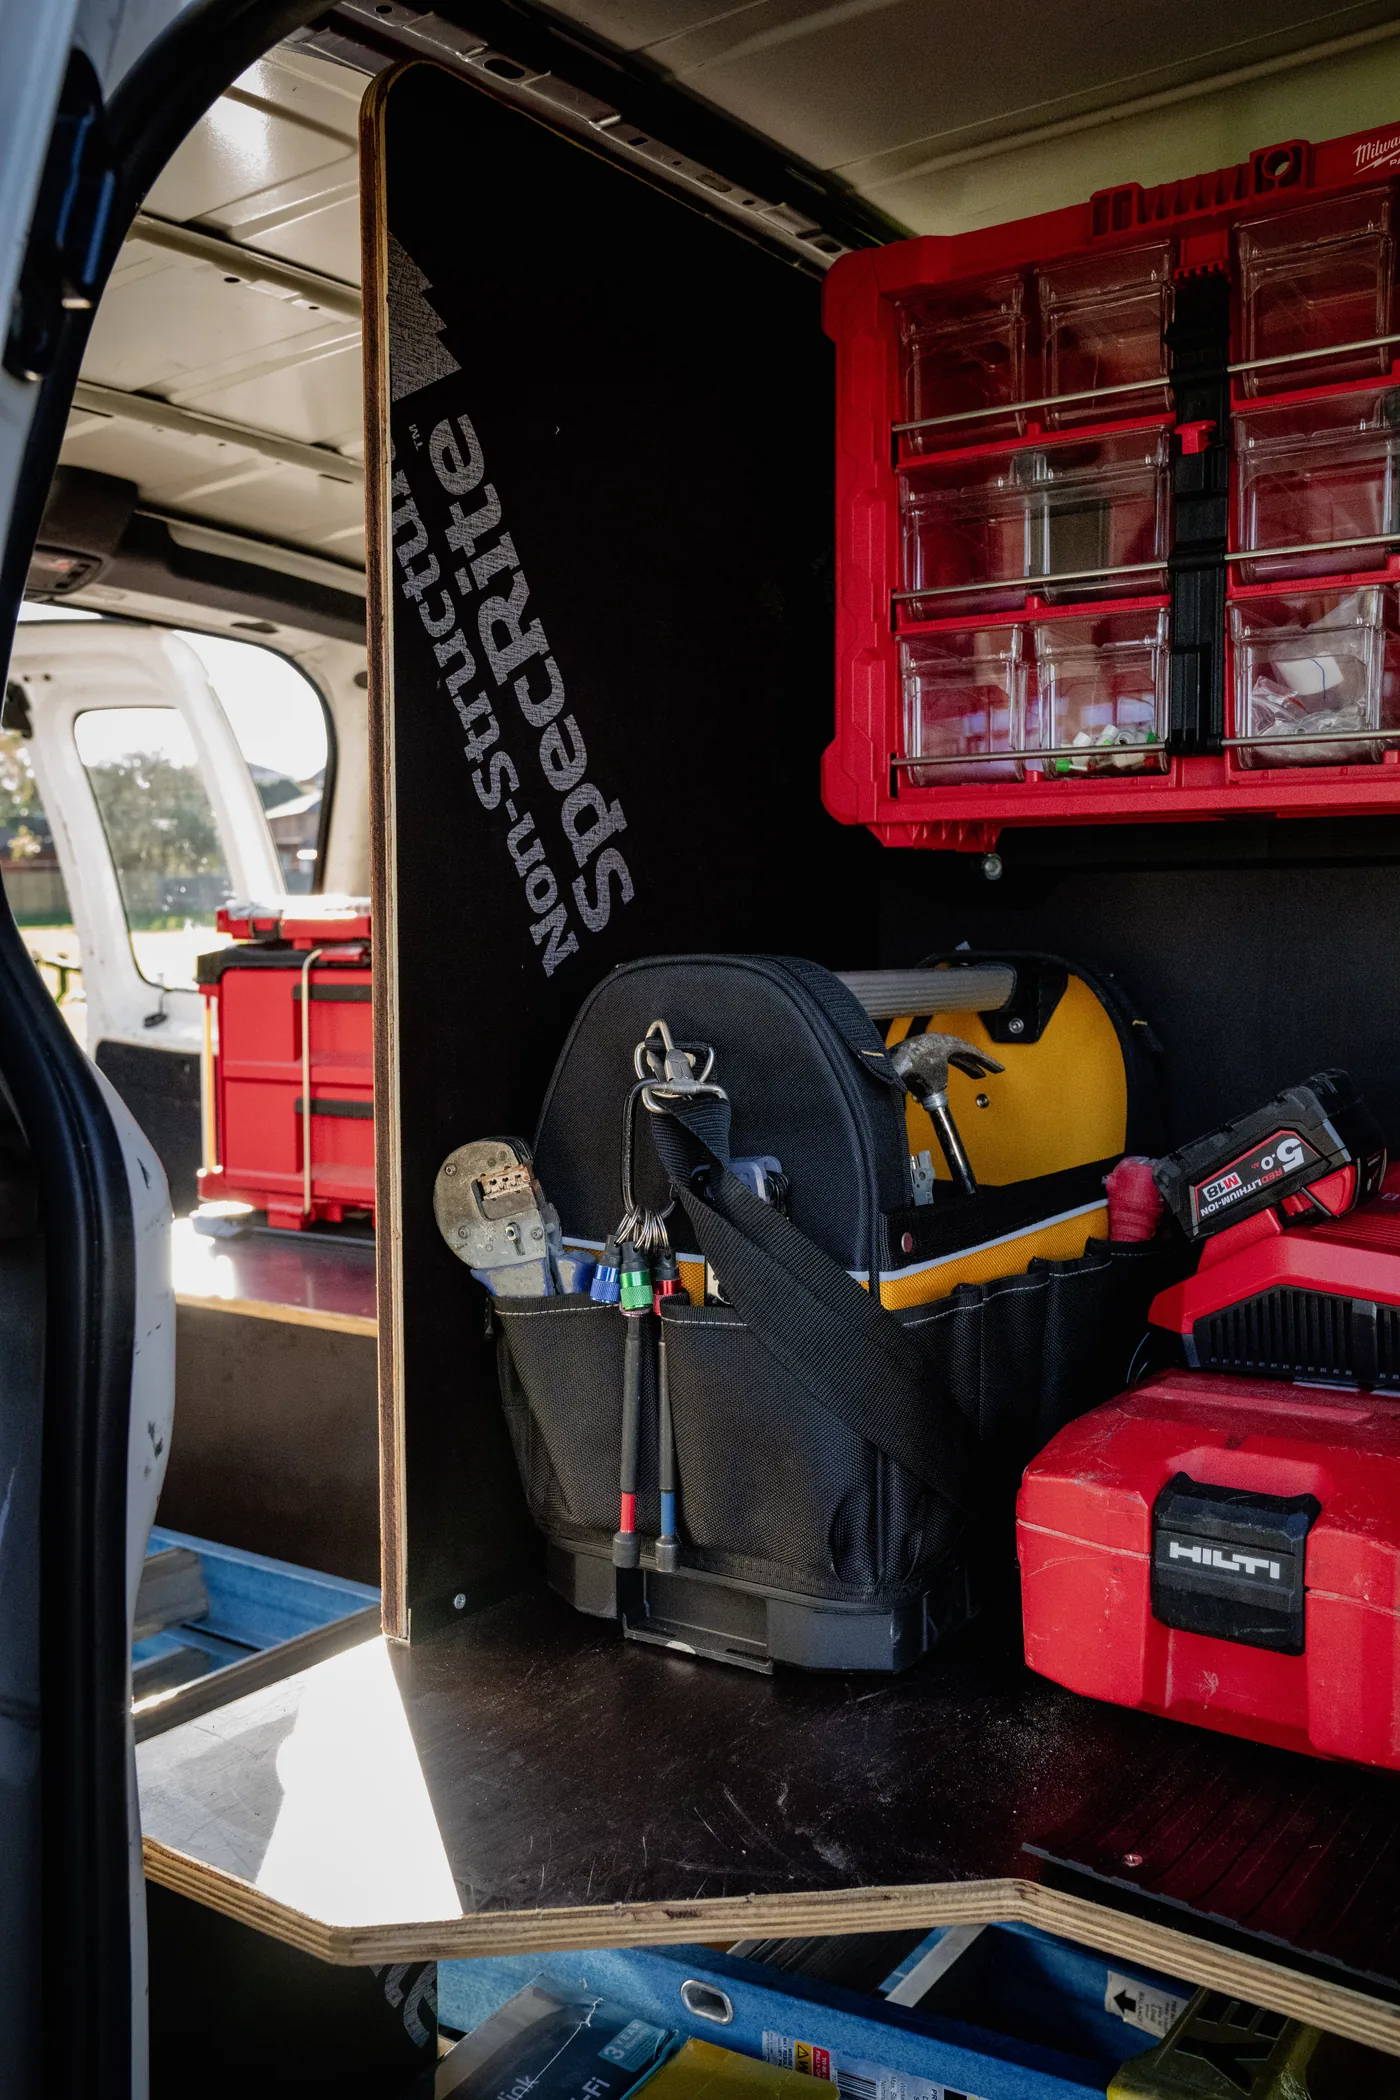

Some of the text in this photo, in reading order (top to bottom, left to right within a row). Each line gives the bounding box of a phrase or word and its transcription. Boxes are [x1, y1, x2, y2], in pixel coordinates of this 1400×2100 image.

[1352, 136, 1400, 167] Milwa
[429, 414, 635, 934] SpecRite
[1206, 1174, 1240, 1199] M18
[1169, 1541, 1280, 1580] HILTI
[603, 2021, 642, 2060] 3 YEAR
